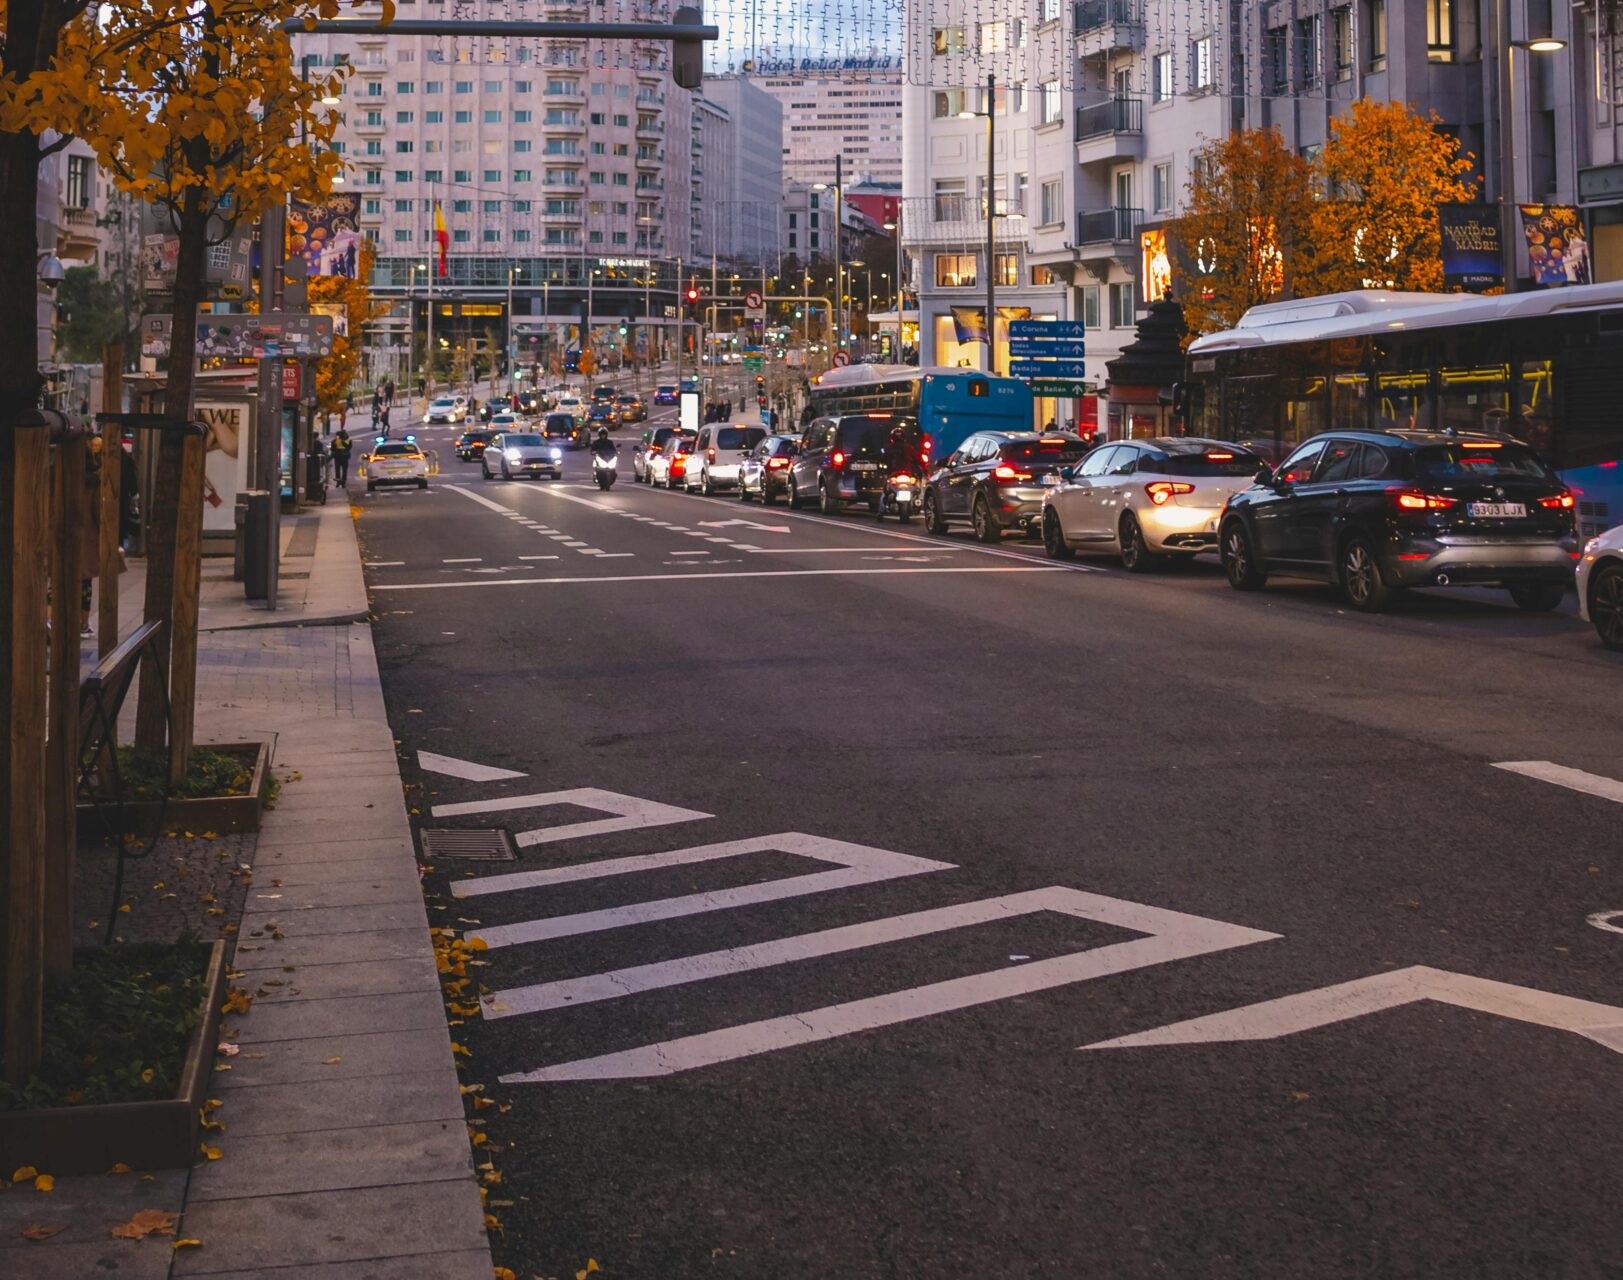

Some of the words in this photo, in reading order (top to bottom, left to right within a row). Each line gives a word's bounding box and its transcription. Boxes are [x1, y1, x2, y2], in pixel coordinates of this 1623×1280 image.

[759, 57, 795, 72] Hotel
[843, 55, 891, 70] Madrid
[1444, 225, 1496, 236] NAVIDAD
[1474, 504, 1500, 515] 9303
[1503, 504, 1523, 515] LJX
